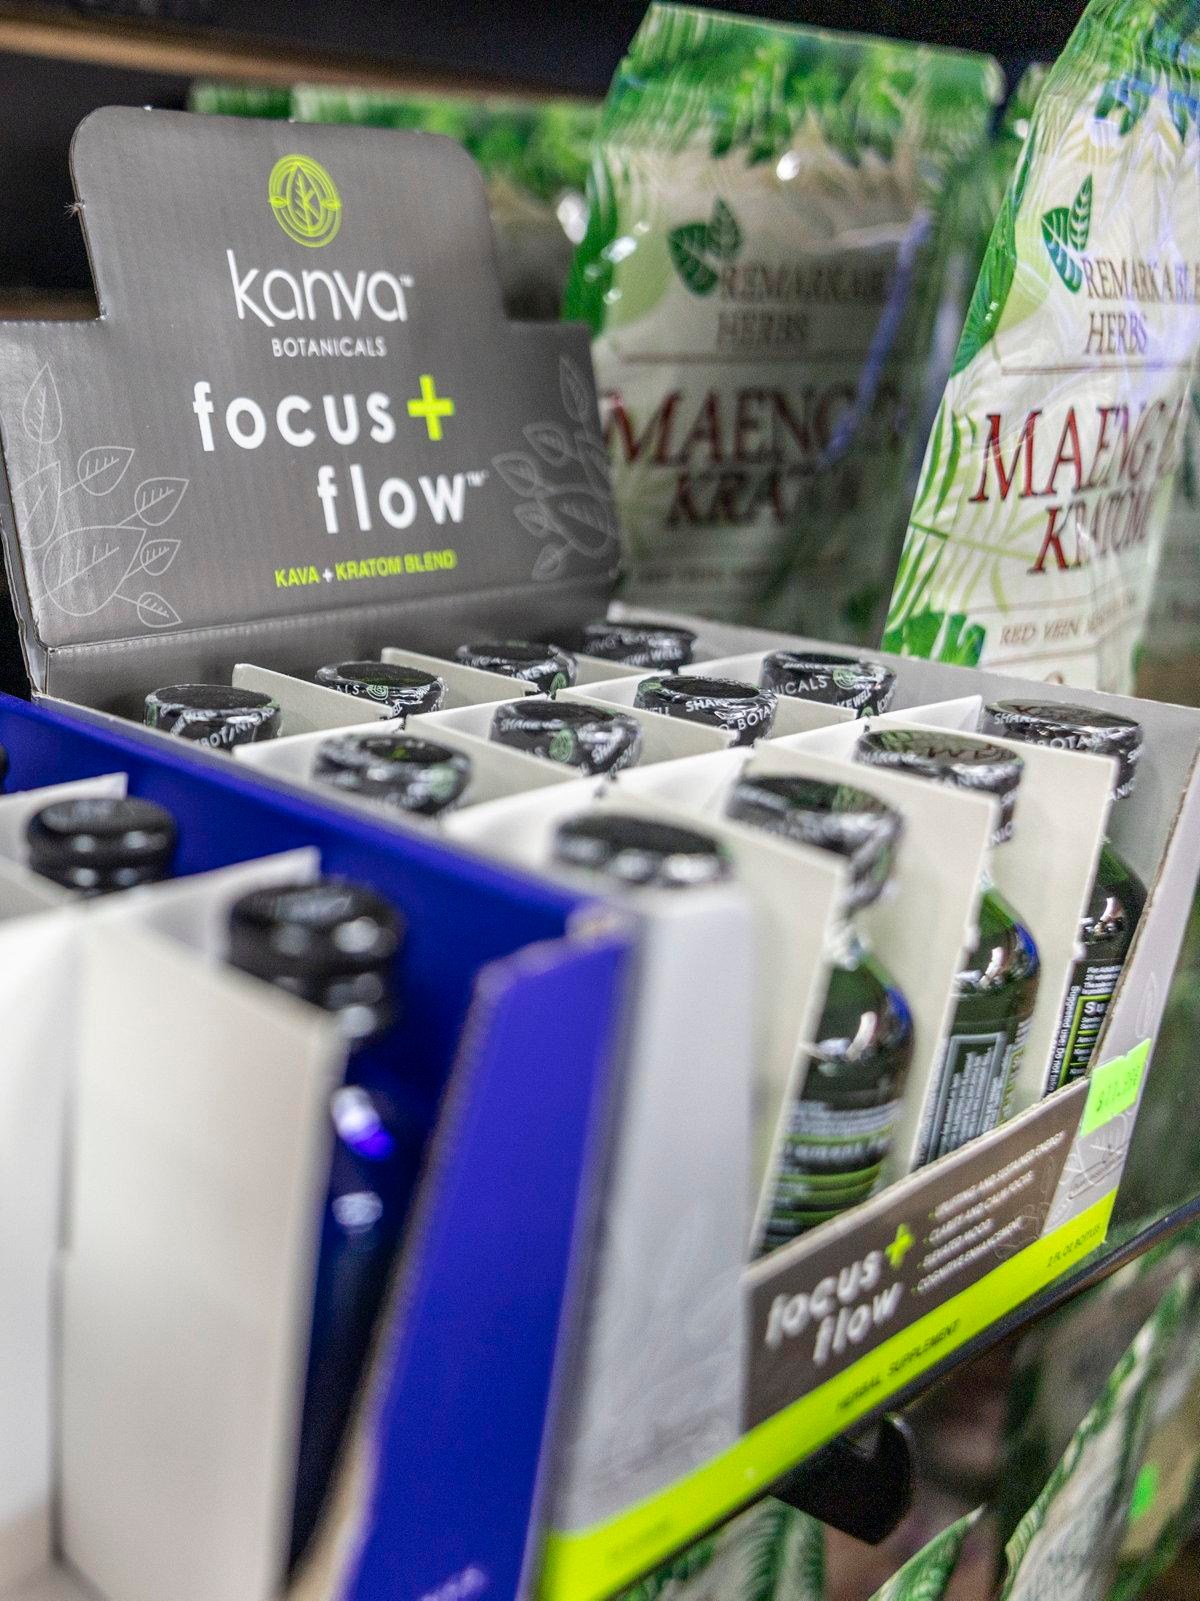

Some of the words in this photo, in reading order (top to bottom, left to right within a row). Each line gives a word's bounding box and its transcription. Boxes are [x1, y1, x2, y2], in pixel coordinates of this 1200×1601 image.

[271, 336, 387, 359] BOTANICALS
[275, 563, 320, 588] KAVA
[335, 554, 402, 582] KRATOM
[404, 548, 457, 575] BLEND
